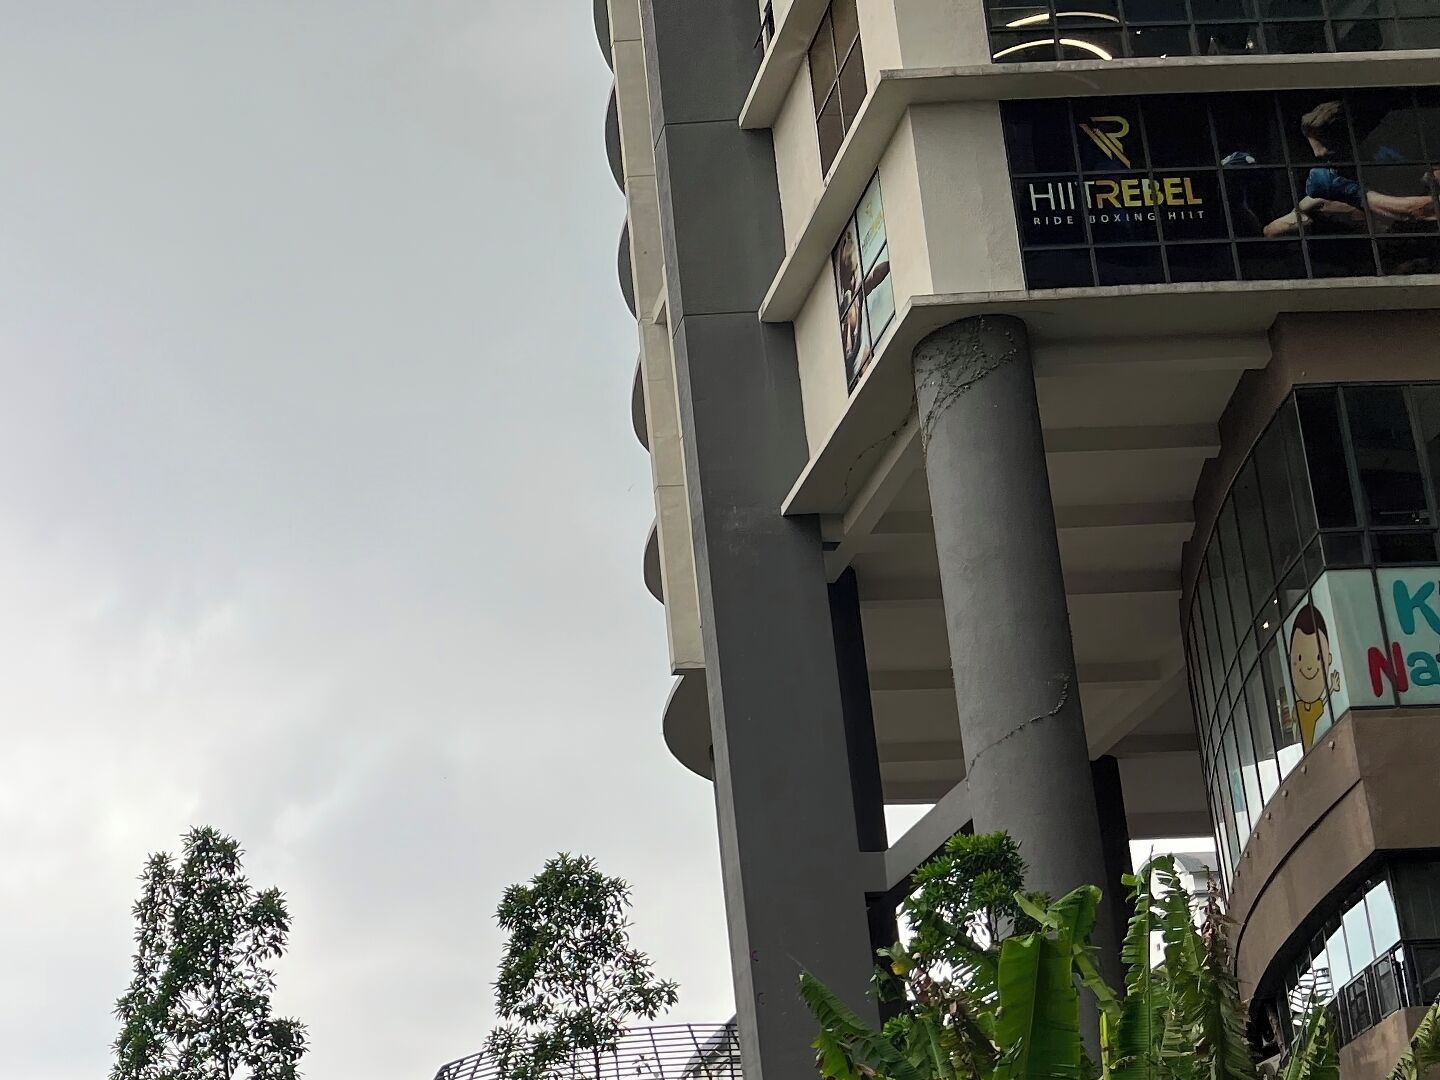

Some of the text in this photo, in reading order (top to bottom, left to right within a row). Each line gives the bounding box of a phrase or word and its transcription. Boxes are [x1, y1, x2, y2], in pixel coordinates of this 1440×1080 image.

[1033, 210, 1205, 225] RIDE BOXING HIIT
[1393, 579, 1440, 636] K
[1367, 641, 1440, 698] Na
